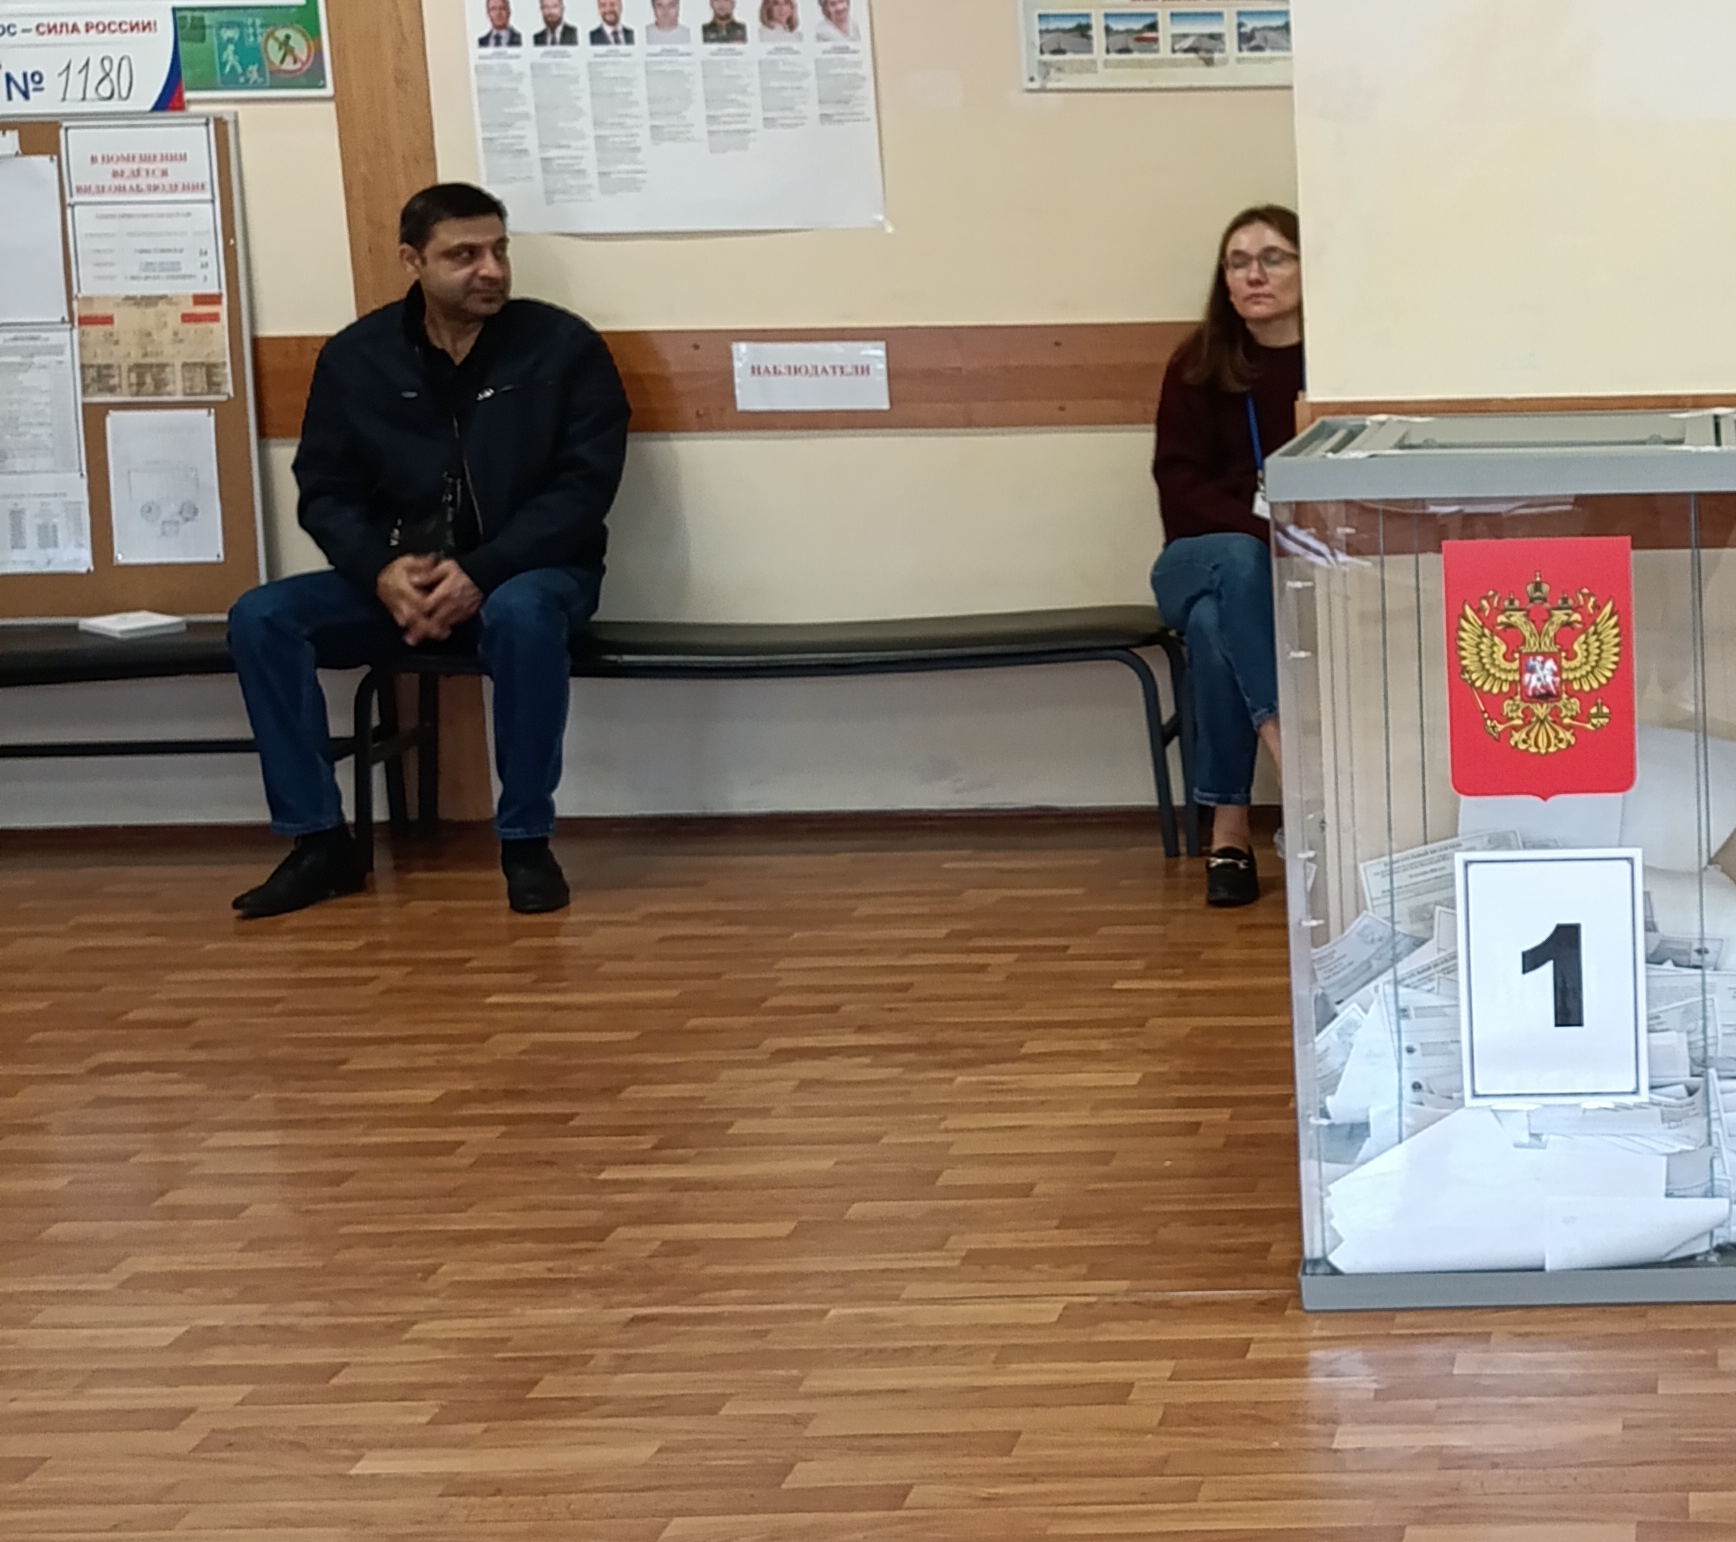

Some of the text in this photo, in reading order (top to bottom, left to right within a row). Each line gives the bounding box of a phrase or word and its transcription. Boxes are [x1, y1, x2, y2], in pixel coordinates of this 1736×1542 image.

[35, 21, 81, 36] СИЛА
[85, 19, 157, 34] РОССИИ!
[5, 54, 133, 102] № 1180
[750, 363, 871, 378] НАБЛЮДАТЕЛИ
[1519, 922, 1585, 1029] 1
